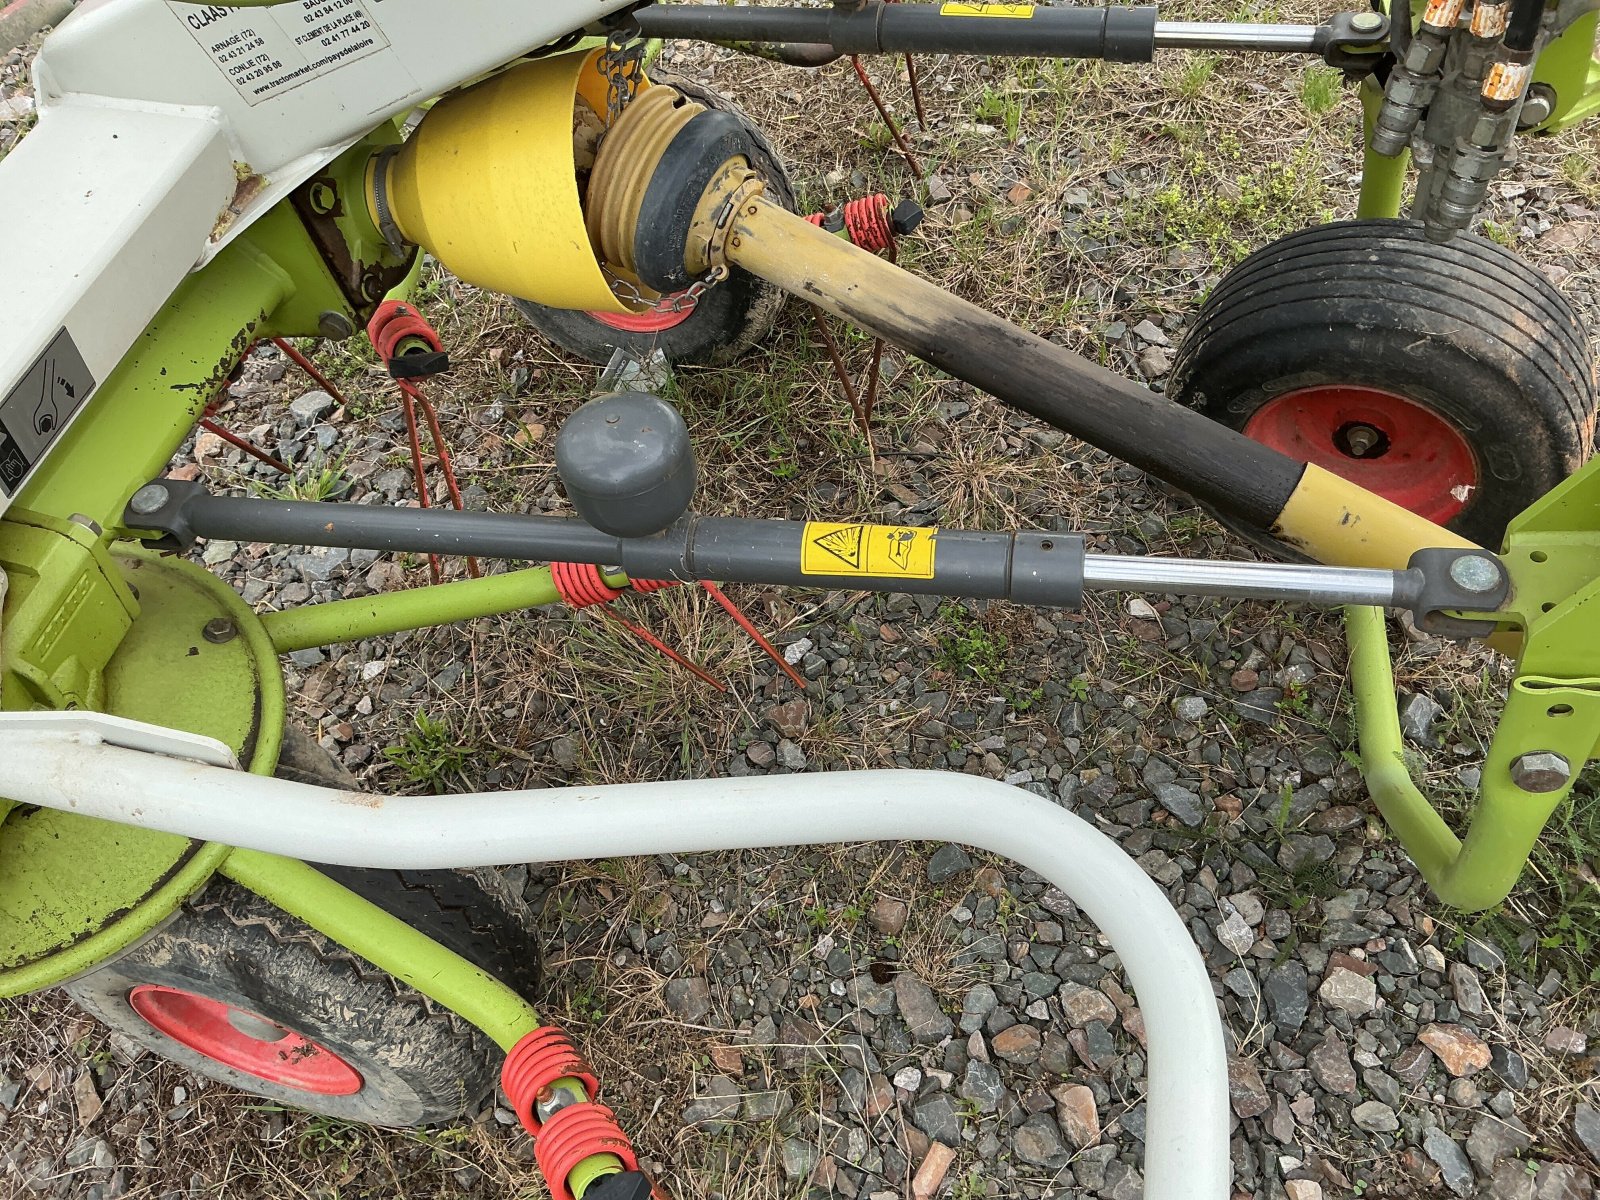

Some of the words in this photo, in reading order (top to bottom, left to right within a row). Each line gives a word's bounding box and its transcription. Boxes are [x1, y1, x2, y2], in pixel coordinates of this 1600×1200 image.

[187, 6, 228, 30] CLAAS
[304, 14, 314, 23] 02
[315, 10, 324, 18] 43
[323, 5, 334, 14] 84
[334, 1, 344, 10] 12
[211, 35, 242, 53] ARNAGE
[241, 29, 256, 41] (72)
[295, 37, 303, 46] ST
[302, 28, 324, 43] CLEMENT
[323, 22, 332, 33] DE
[330, 20, 339, 30] LA
[338, 14, 355, 27] PLACE
[321, 38, 332, 47] 02
[332, 34, 341, 42] 41
[340, 29, 350, 38] 77
[351, 25, 361, 33] 44
[360, 20, 371, 29] 20
[218, 54, 228, 63] 02
[228, 50, 237, 59] 43
[236, 46, 246, 55] 21
[245, 42, 255, 51] 24
[254, 38, 264, 46] 58
[228, 59, 256, 75] CONLIE
[255, 54, 270, 65] (72)
[236, 77, 246, 85] 02
[246, 73, 255, 81] 43
[254, 69, 264, 77] 20
[263, 64, 273, 73] 95
[272, 60, 282, 69] 08
[253, 38, 374, 95] www.tractomarket.com/paysdelaloire
